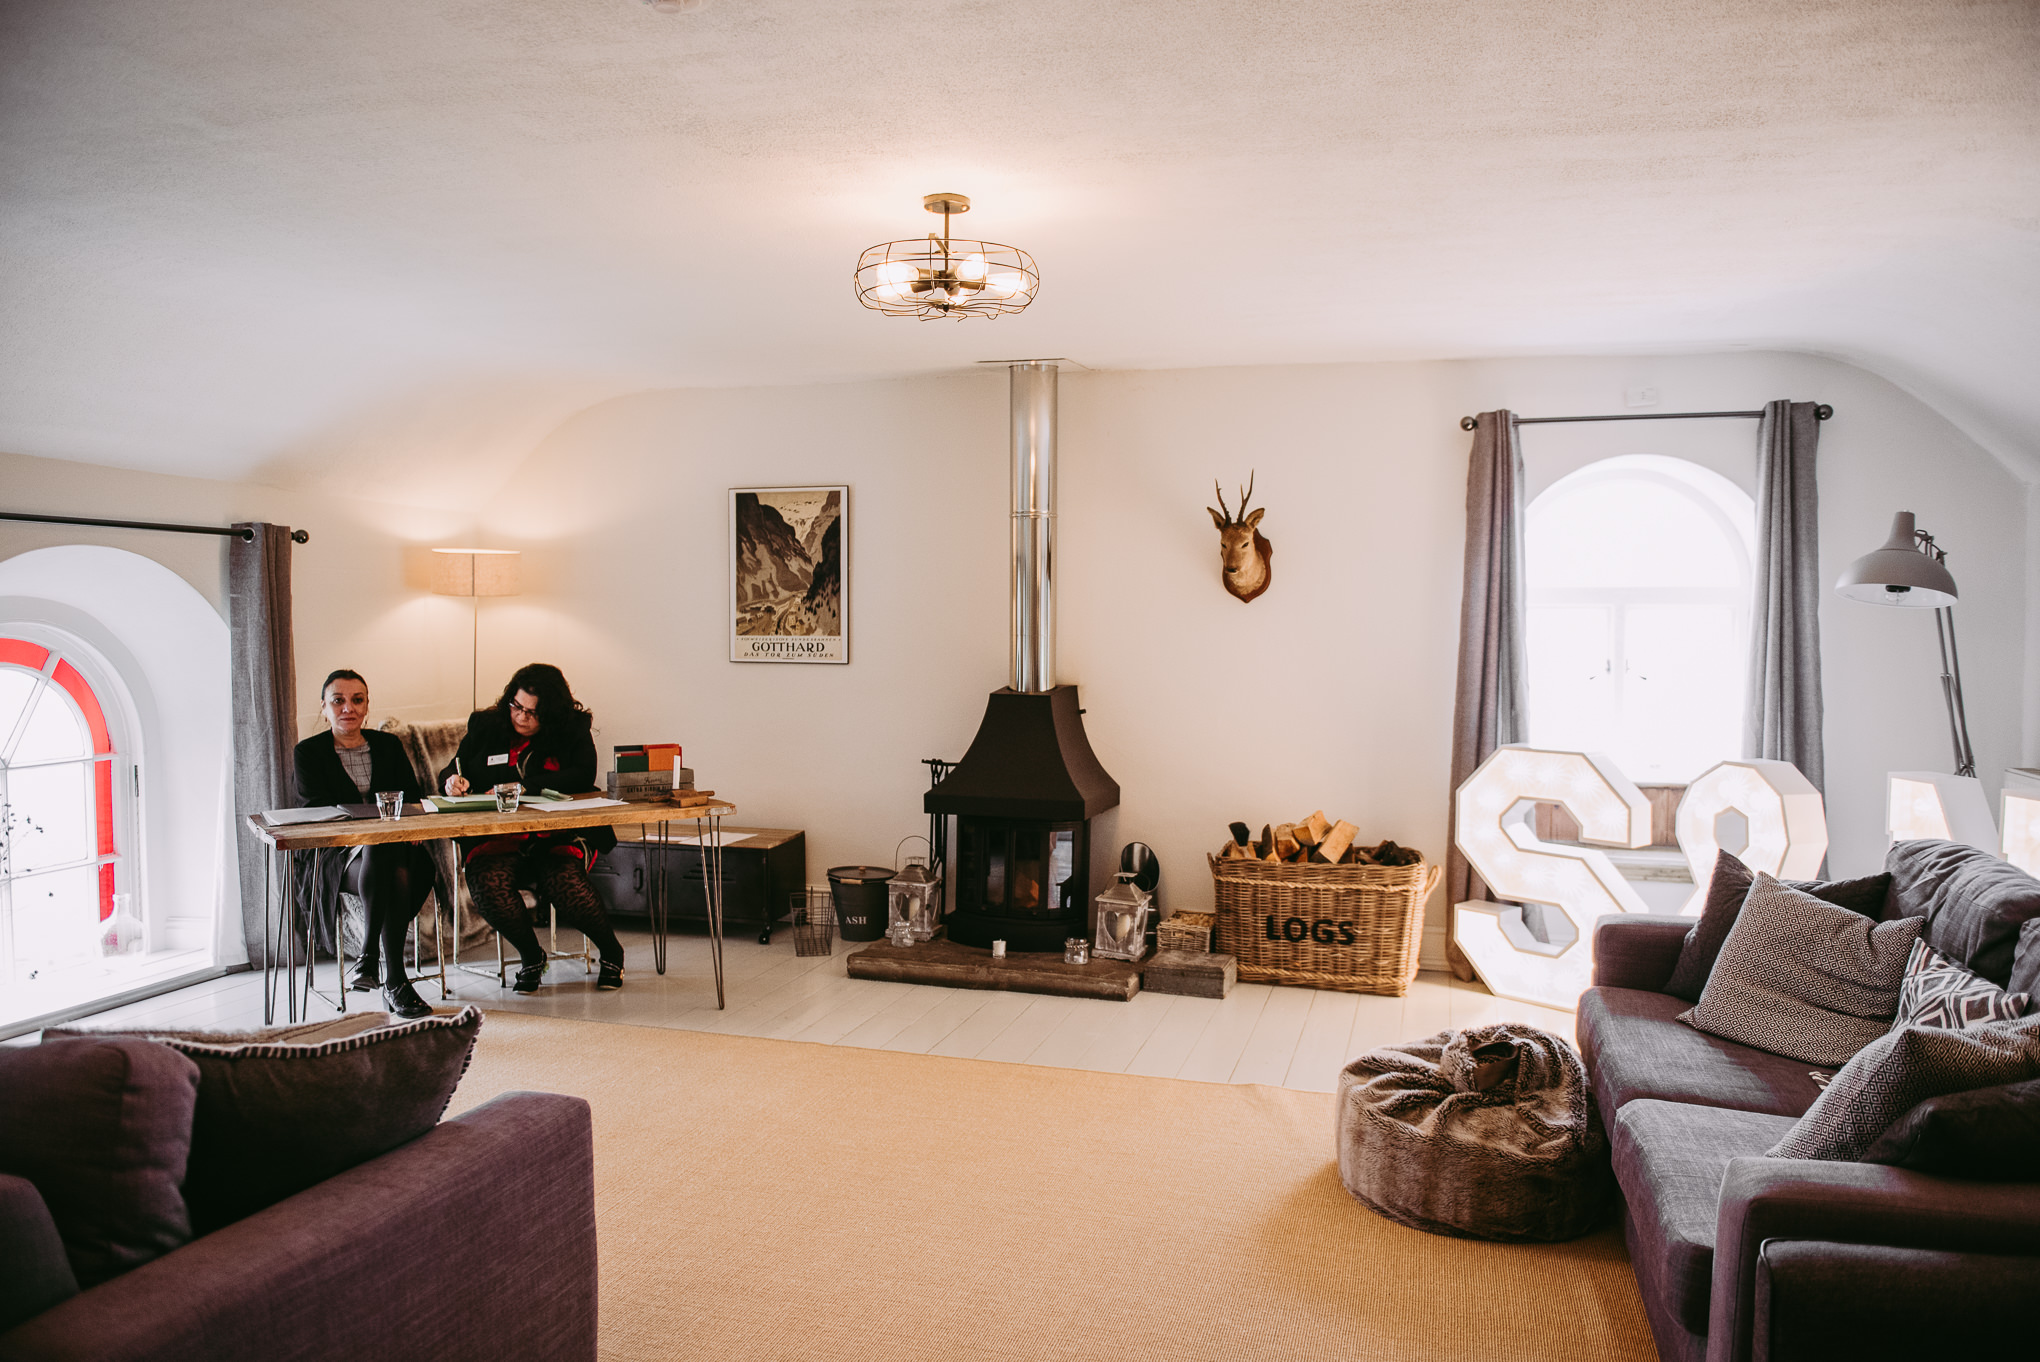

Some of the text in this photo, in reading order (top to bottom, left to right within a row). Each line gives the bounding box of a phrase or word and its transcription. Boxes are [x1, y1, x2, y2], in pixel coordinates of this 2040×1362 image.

[751, 641, 825, 653] GOTTHARD
[845, 915, 867, 925] ASH
[1265, 915, 1355, 945] LOGS
